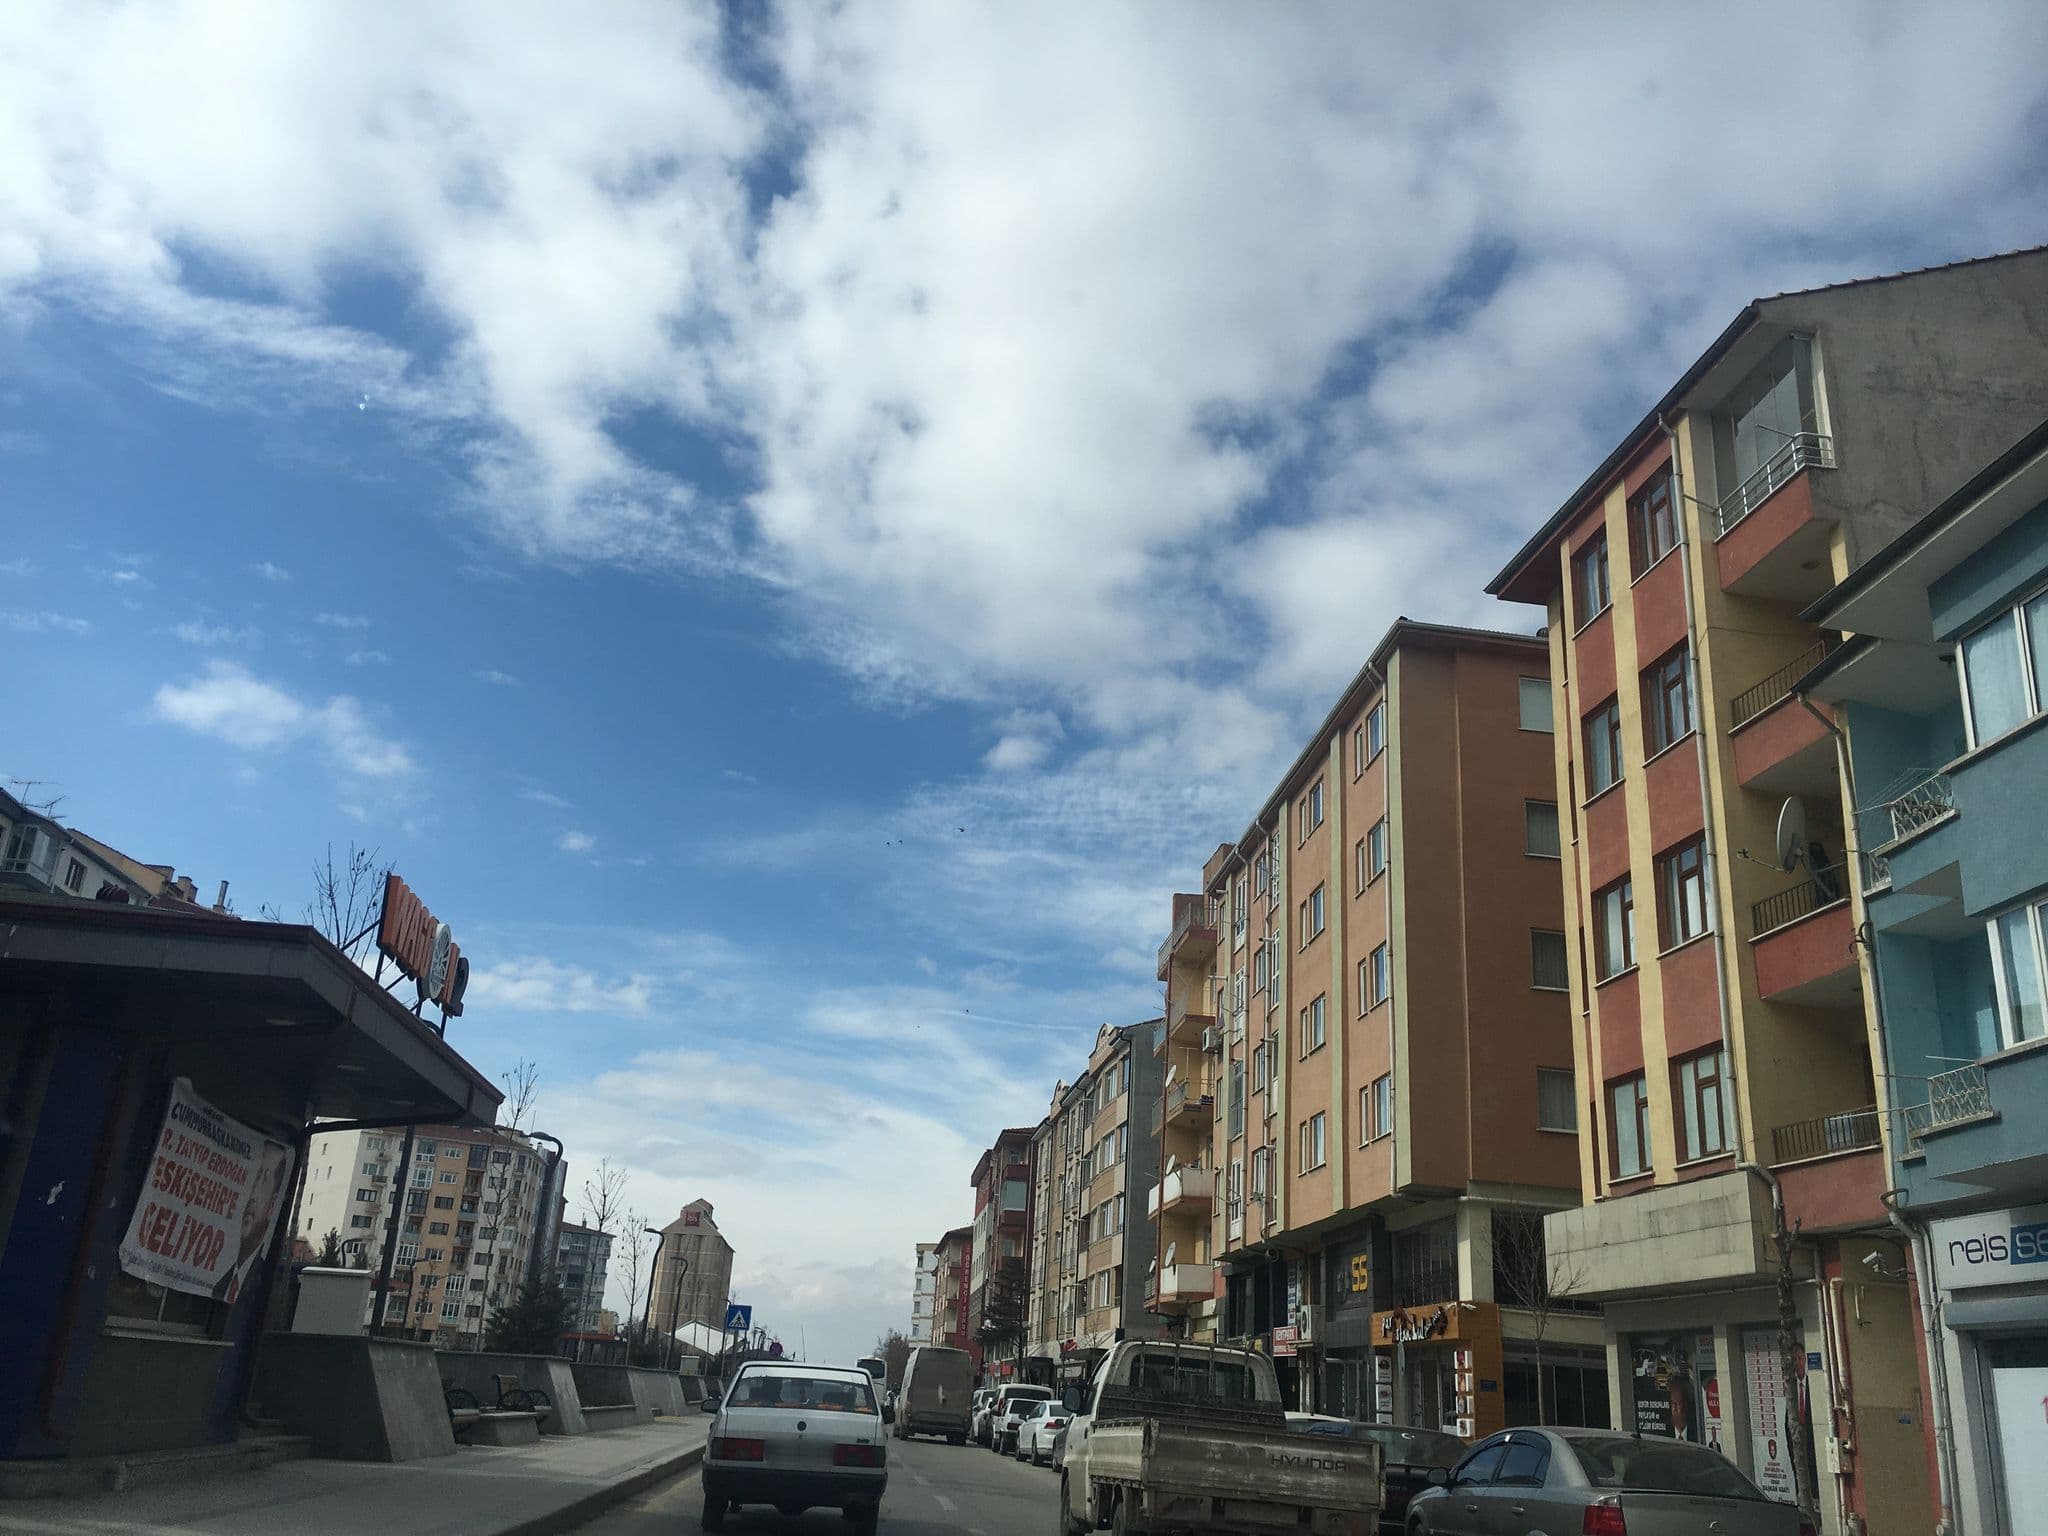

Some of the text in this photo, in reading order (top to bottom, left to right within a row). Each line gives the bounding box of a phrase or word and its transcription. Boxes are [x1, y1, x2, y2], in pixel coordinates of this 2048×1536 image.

[161, 1128, 172, 1151] R.
[138, 1202, 225, 1272] GELİYOR
[1949, 1233, 2009, 1266] reis
